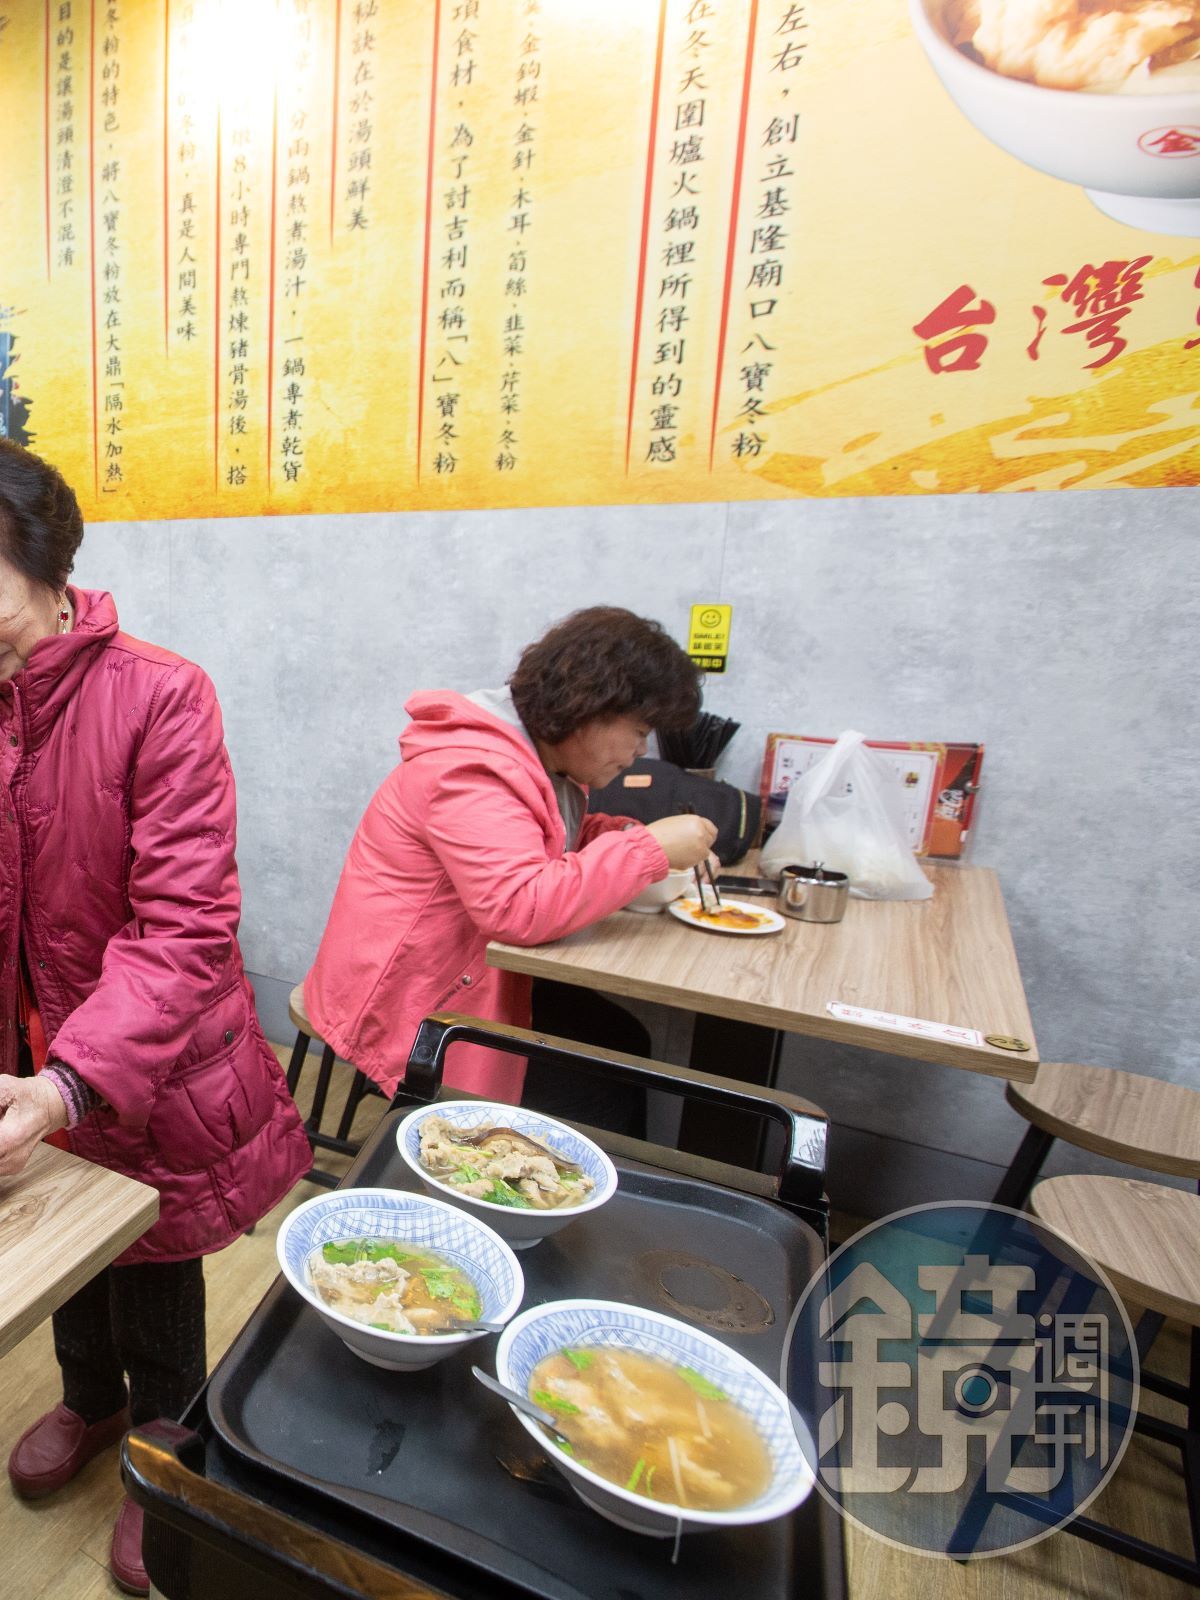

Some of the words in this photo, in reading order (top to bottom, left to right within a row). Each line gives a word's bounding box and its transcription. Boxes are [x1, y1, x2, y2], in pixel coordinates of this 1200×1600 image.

[102, 0, 125, 493] 冬粉的特色，將八寶冬粉放在大鼎「隔水加熱」
[912, 254, 1200, 376] 台灣
